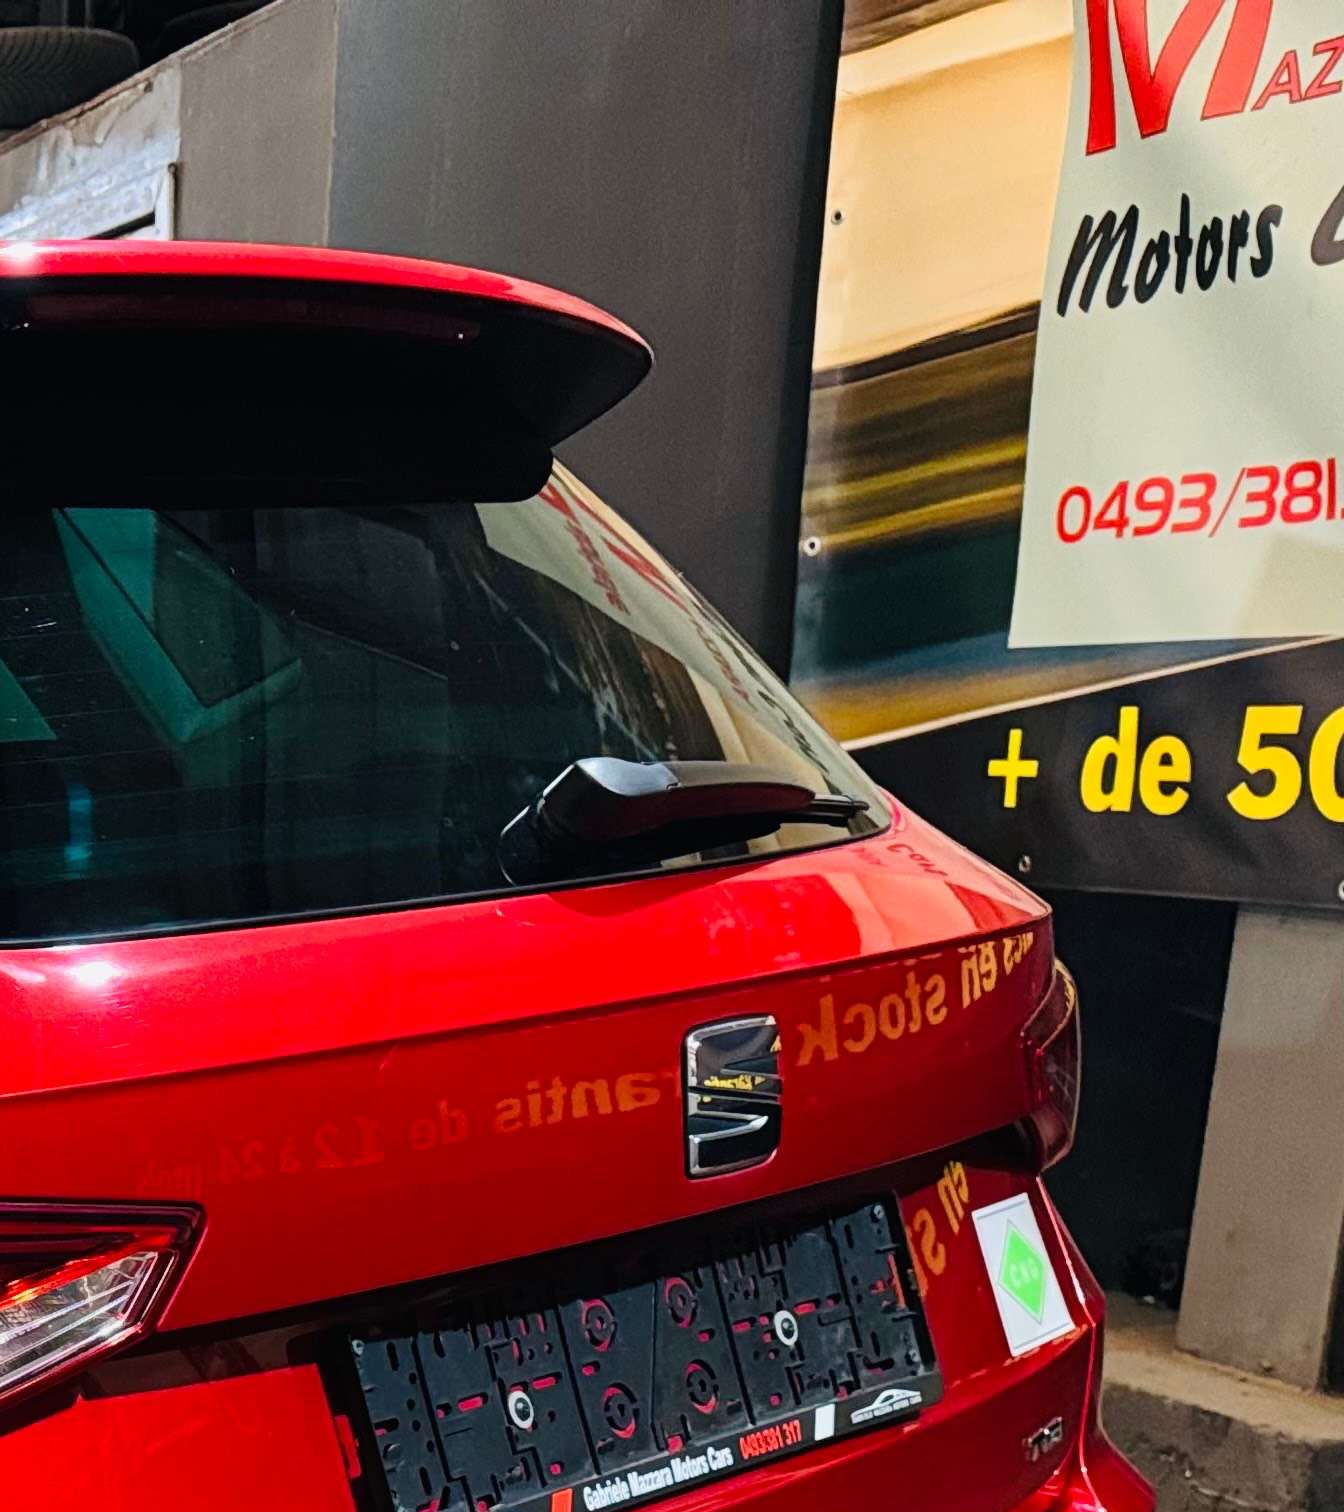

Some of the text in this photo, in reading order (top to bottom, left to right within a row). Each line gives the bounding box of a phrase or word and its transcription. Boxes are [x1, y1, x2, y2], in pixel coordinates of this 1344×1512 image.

[1056, 192, 1283, 318] Motors
[1054, 457, 1344, 544] 0493/381
[1080, 705, 1192, 816] de
[583, 1477, 630, 1512] Gabriele
[627, 1466, 674, 1497] Mazzara
[670, 1455, 709, 1483] Motors
[707, 1446, 734, 1471] Cars
